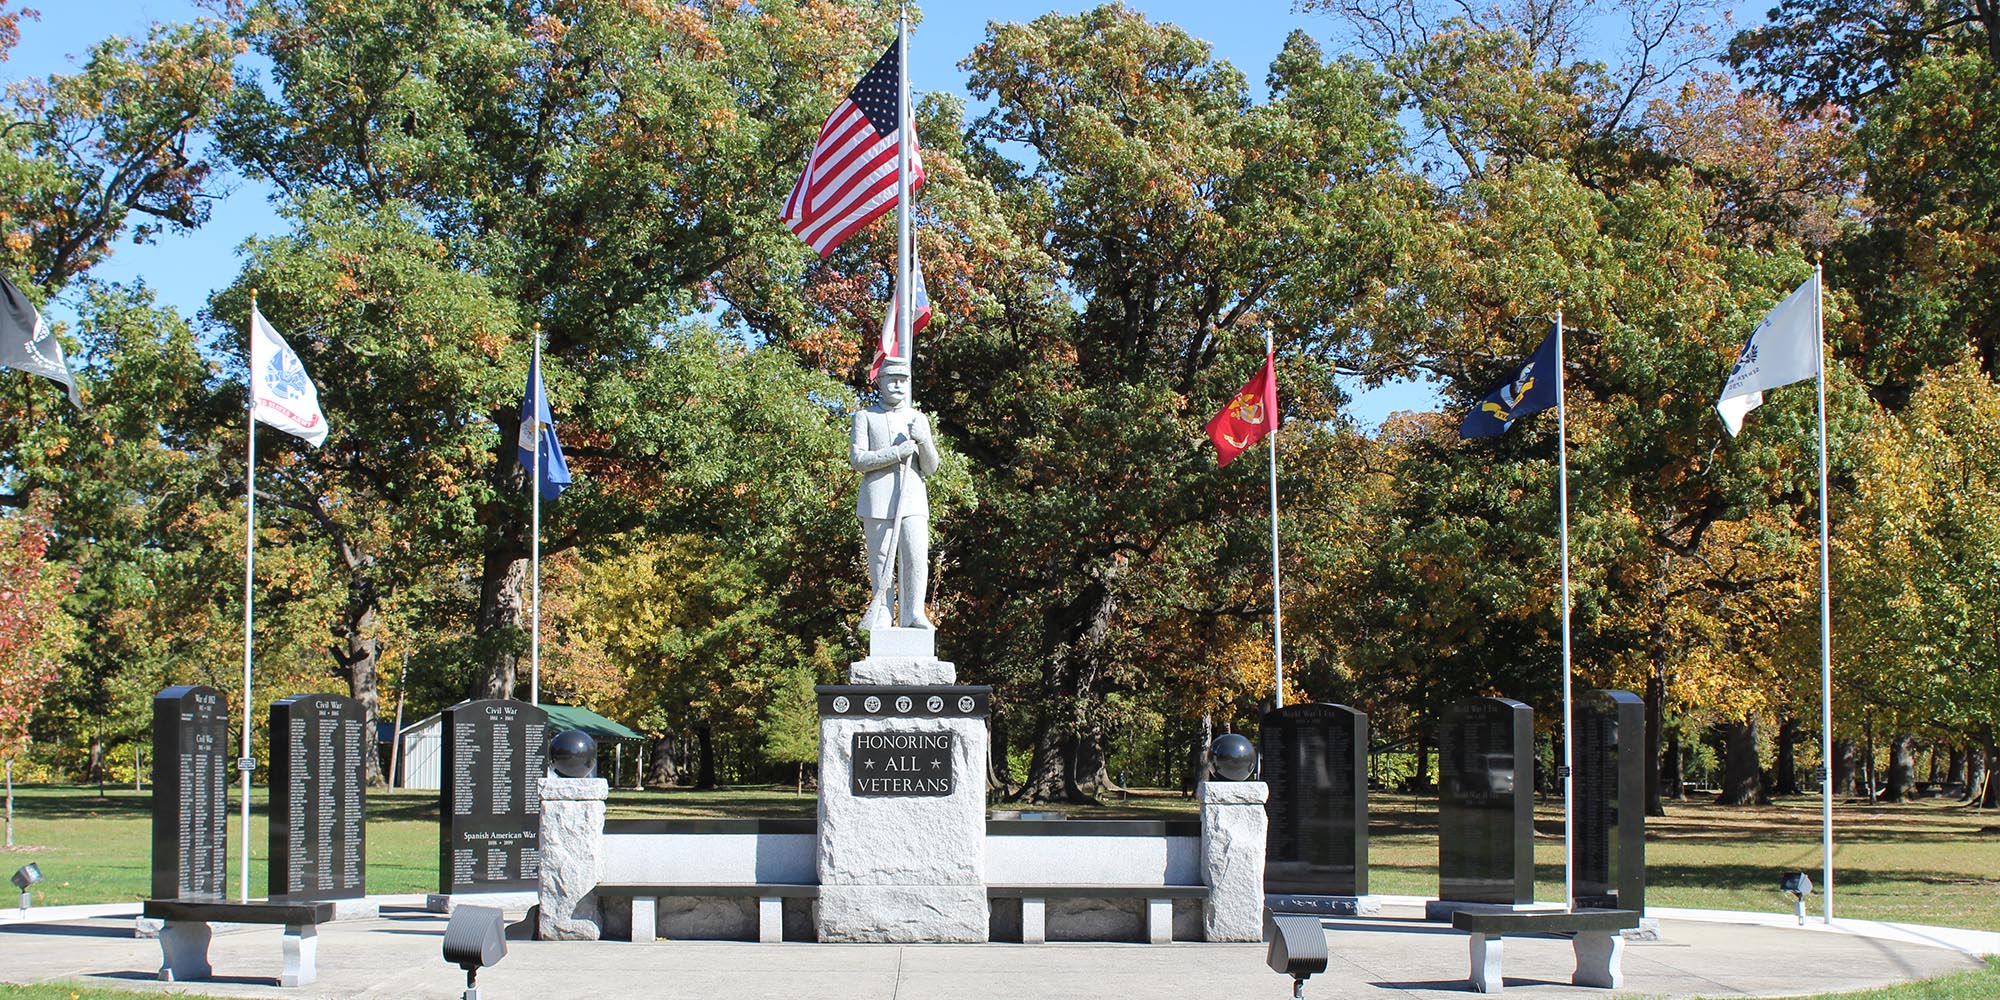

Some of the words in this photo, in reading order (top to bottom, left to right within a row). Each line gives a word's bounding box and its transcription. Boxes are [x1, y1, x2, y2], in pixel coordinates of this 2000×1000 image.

[315, 700, 329, 709] Civil
[330, 700, 342, 709] War
[485, 706, 502, 714] Civil
[503, 706, 518, 714] War
[196, 734, 205, 743] Civil
[857, 735, 948, 749] HONORING
[884, 756, 921, 771] ALL
[857, 778, 949, 792] VETERANS
[463, 831, 489, 842] Spanish
[490, 831, 522, 840] American
[523, 831, 536, 839] War
